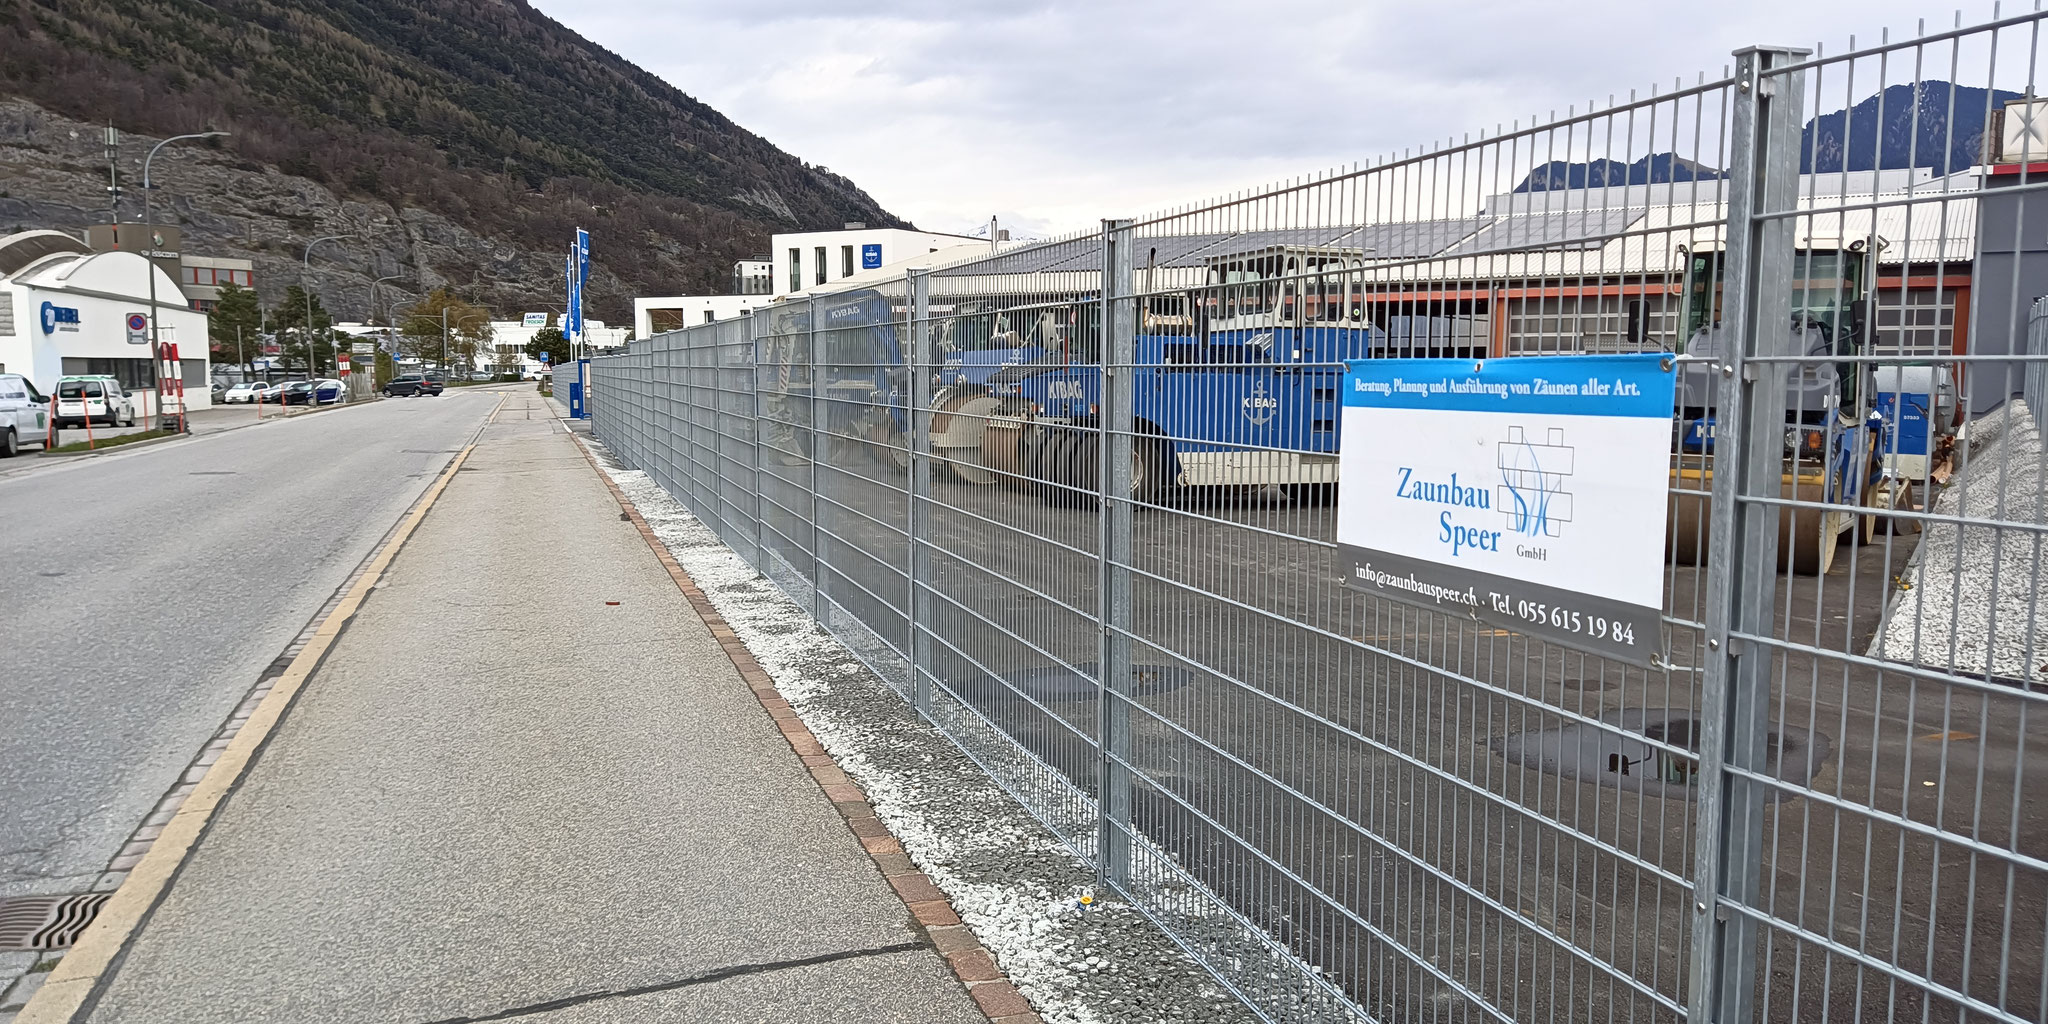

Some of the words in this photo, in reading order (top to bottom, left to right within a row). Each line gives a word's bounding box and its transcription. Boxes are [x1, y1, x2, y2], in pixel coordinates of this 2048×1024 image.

[1243, 397, 1277, 408] KBAG
[1355, 377, 1392, 397] Beratung,
[1393, 377, 1428, 398] Planung
[1429, 377, 1447, 393] und
[1449, 377, 1508, 400] Ausführung
[1509, 383, 1531, 395] von
[1533, 378, 1578, 396] Zäunen
[1581, 377, 1611, 396] aller
[1613, 378, 1641, 396] Art.
[1396, 467, 1491, 510] Zaunbau
[1439, 510, 1501, 557] Speer
[1516, 544, 1547, 561] GmbH
[1355, 562, 1478, 607] info@zaunbauspeer.ch
[1488, 591, 1515, 616] Tel.
[1518, 600, 1547, 625] 055
[1551, 606, 1581, 633] 615
[1587, 615, 1607, 639] 19
[1612, 621, 1635, 646] 84
